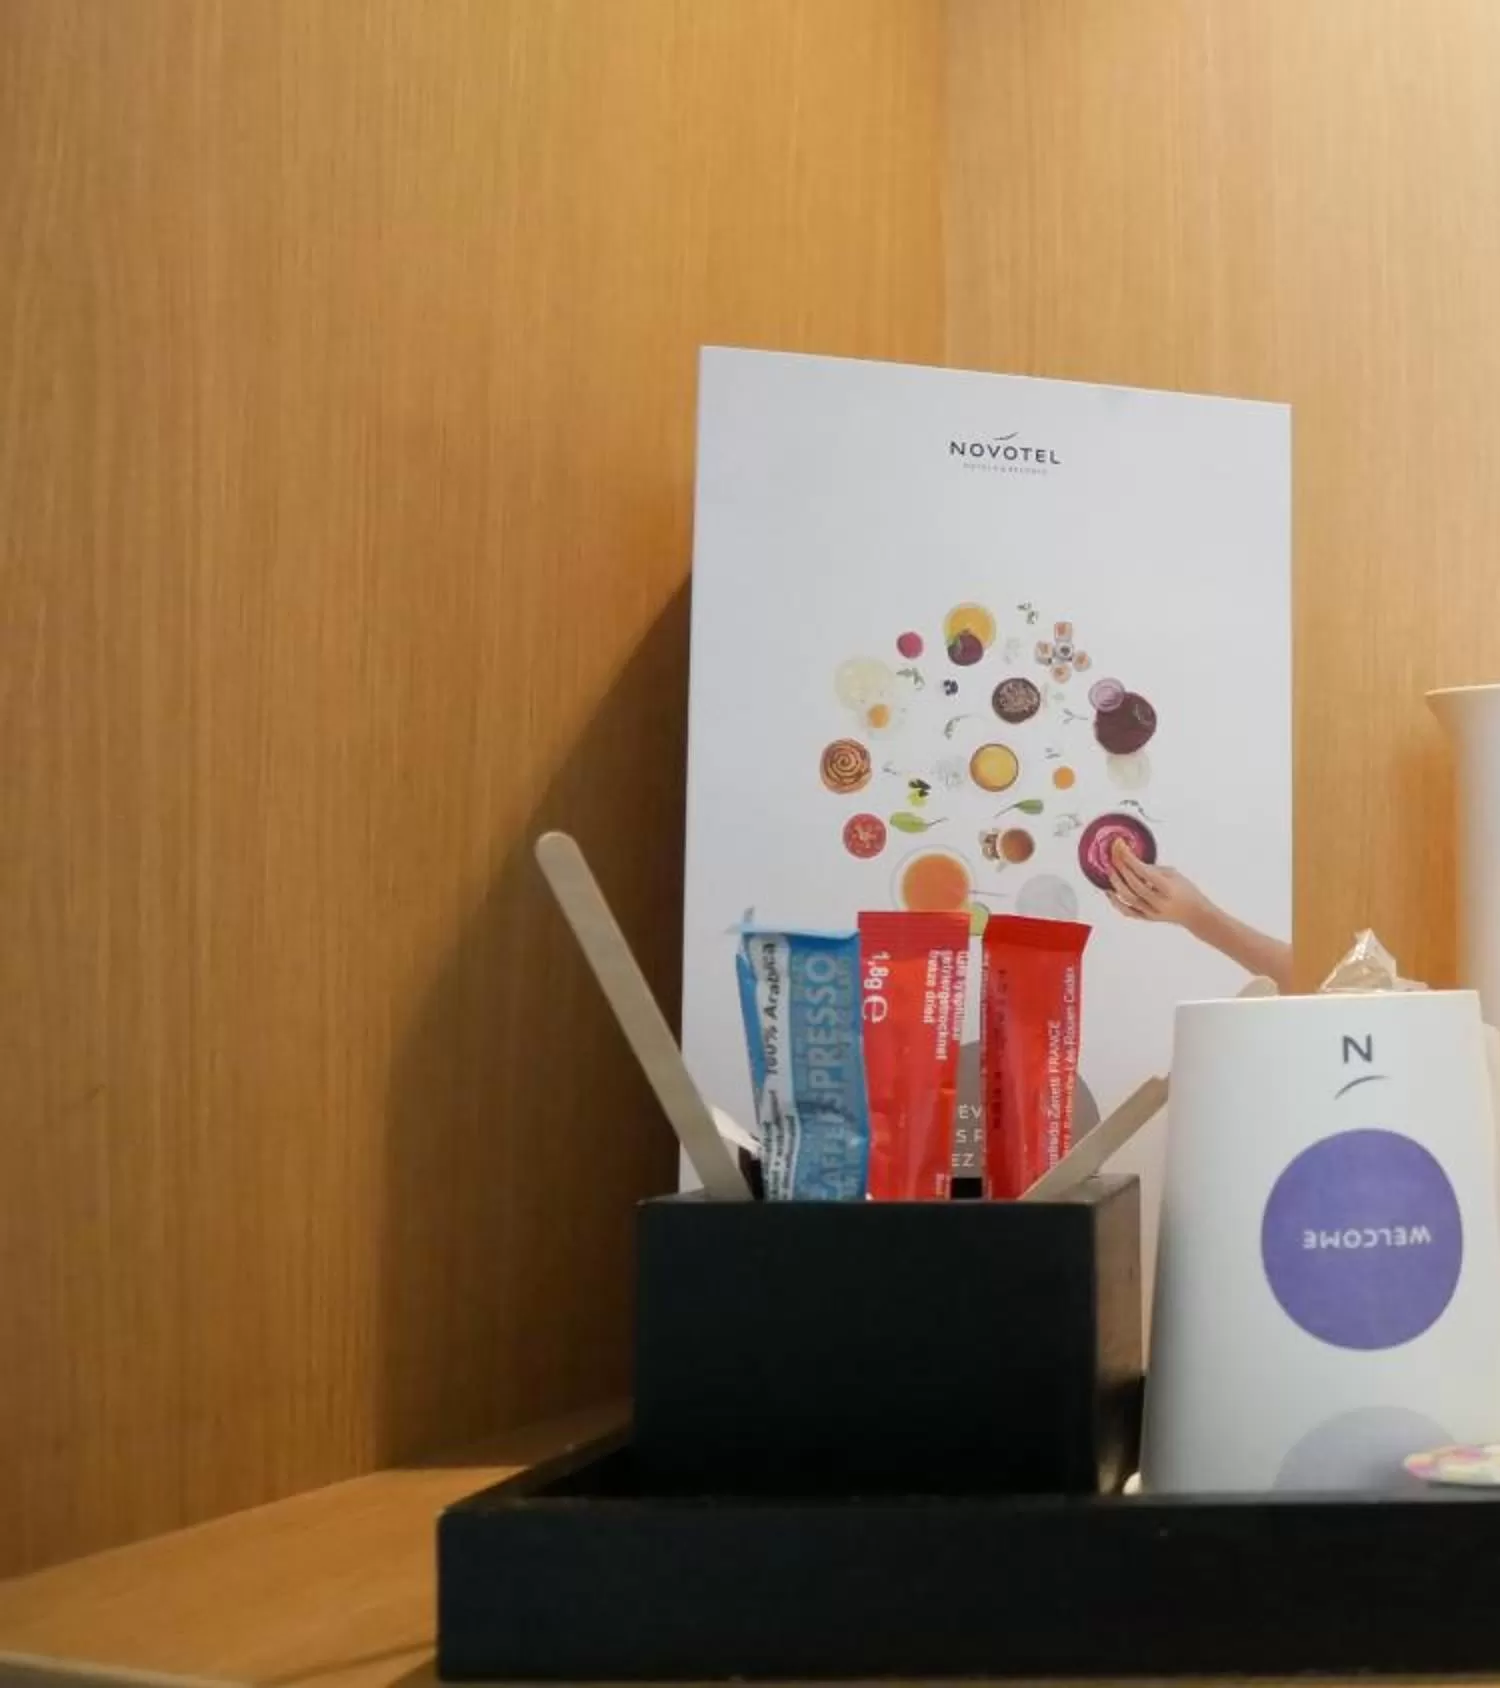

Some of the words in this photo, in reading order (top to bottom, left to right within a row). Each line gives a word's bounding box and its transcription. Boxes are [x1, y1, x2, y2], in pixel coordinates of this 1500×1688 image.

[949, 441, 1061, 465] NOVOTEL
[762, 942, 780, 1020] Arabica
[863, 950, 890, 989] 1,8g
[923, 990, 938, 1024] dried
[763, 1024, 779, 1075] 100%
[1046, 1019, 1061, 1073] FRANCE
[1341, 1033, 1373, 1064] N
[1303, 1225, 1431, 1249] WELCOME
